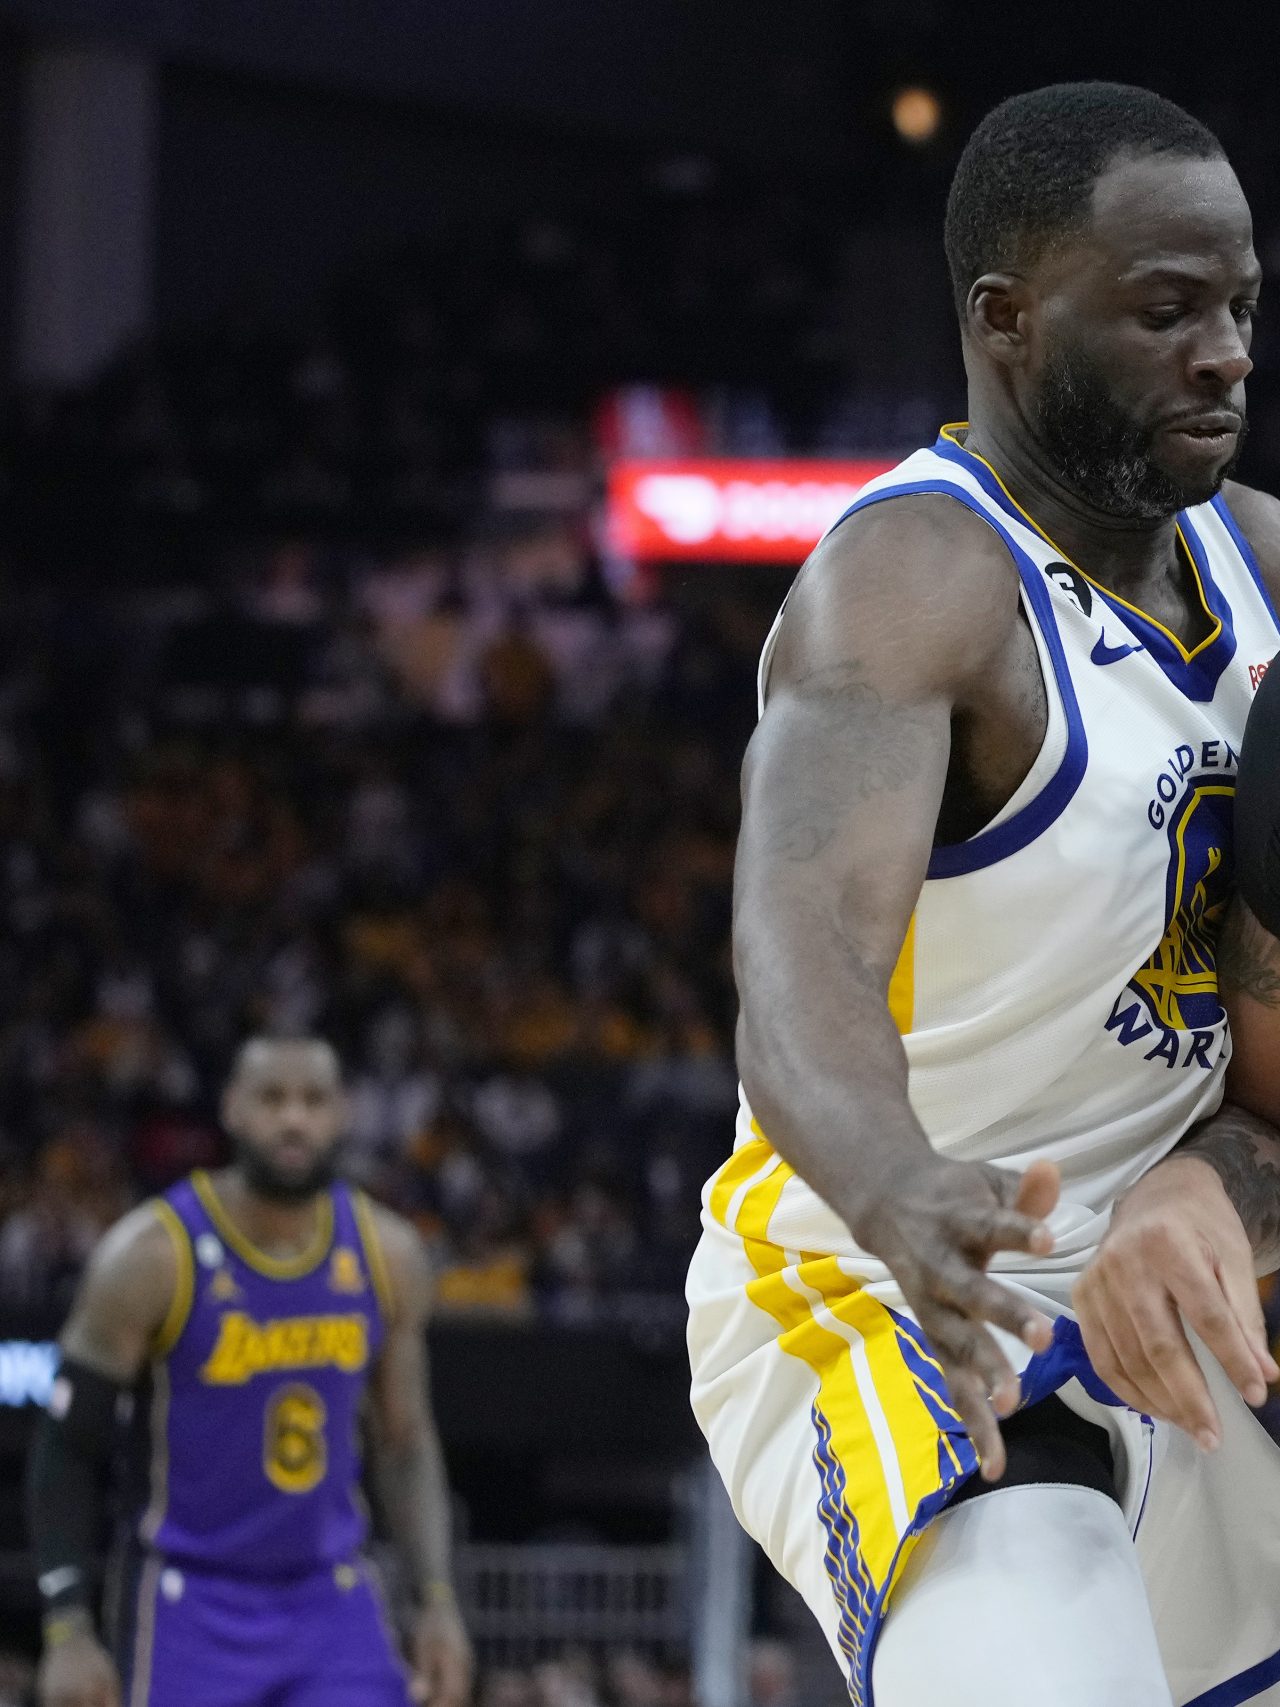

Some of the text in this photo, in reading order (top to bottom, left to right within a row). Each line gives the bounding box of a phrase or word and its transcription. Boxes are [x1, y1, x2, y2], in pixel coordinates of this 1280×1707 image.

[1147, 740, 1240, 830] GOLDEN
[1103, 988, 1226, 1070] WAR
[264, 1384, 328, 1494] 6
